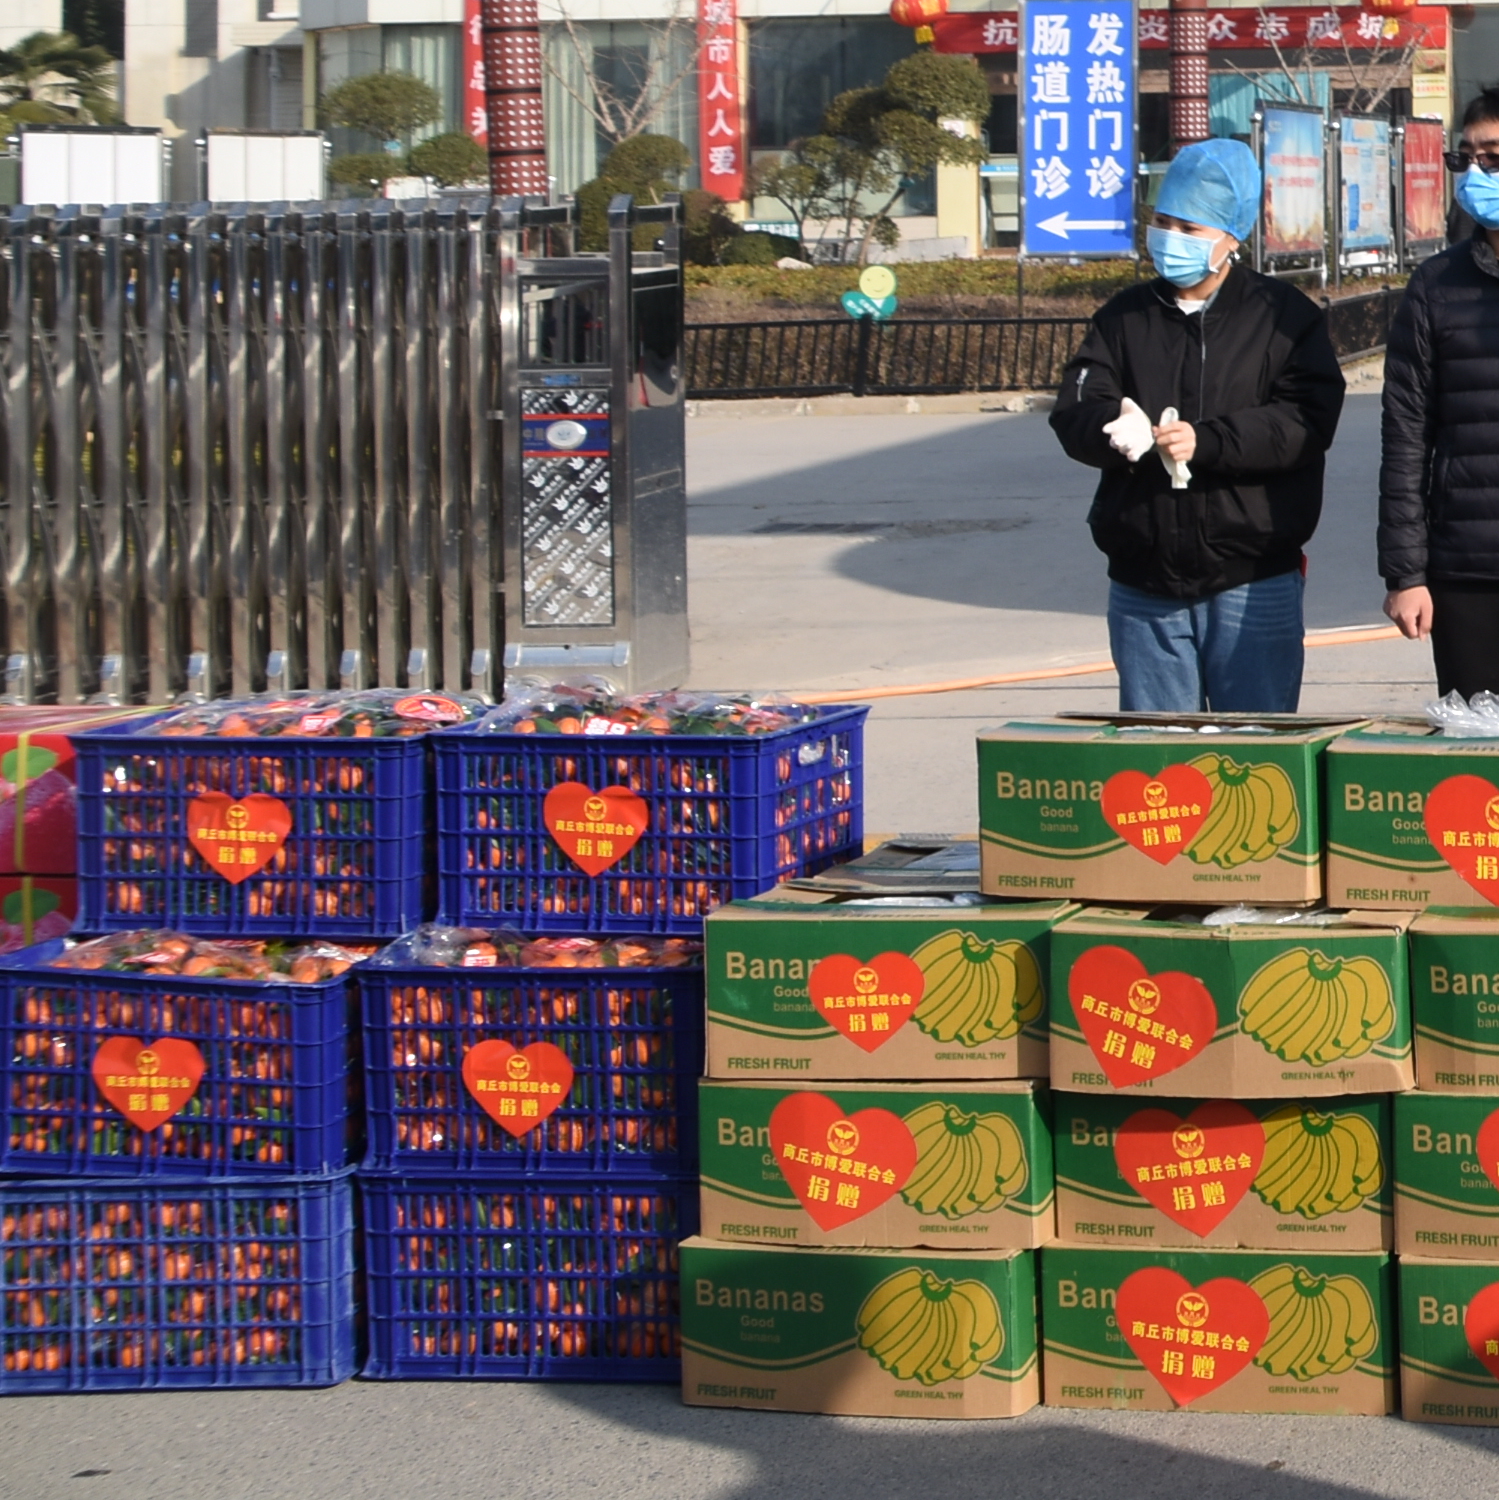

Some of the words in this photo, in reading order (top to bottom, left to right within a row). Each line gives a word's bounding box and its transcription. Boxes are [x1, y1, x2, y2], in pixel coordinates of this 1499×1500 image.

[1031, 14, 1072, 200] 肠道门诊
[1085, 12, 1126, 200] 发热门诊
[1040, 806, 1073, 818] Good
[1116, 803, 1201, 825] 商丘市博爱联合会
[555, 820, 635, 836] 商丘市博爱联合会
[1040, 821, 1079, 833] banana
[1142, 824, 1182, 846] 捐赠
[197, 828, 277, 843] 商丘市博爱联合会
[577, 838, 613, 857] 捐赠
[998, 875, 1037, 888] FRESH
[1040, 877, 1076, 889] FRUIT
[1193, 874, 1220, 882] GREEN
[1346, 888, 1388, 900] FRESH
[1391, 889, 1431, 902] FRUIT
[823, 993, 912, 1009] 商丘市博爱联合会
[849, 1013, 890, 1032] 捐赠
[1081, 994, 1194, 1050] 商丘市博爱联合会
[935, 1052, 964, 1060] GREEN
[1102, 1030, 1156, 1069] 捐赠
[728, 1057, 770, 1070] FRESH
[773, 1058, 811, 1070] FRUIT
[1281, 1072, 1311, 1080] GREEN
[1435, 1072, 1475, 1086] FRESH
[477, 1080, 561, 1094] 商丘市博爱联合会
[500, 1097, 538, 1116] 捐赠
[783, 1143, 896, 1185] 商丘市博爱联合会
[1136, 1153, 1252, 1183] 商丘市博爱联合会
[807, 1175, 861, 1209] 捐赠
[1172, 1181, 1226, 1211] 捐赠
[721, 1223, 760, 1237] FRESH
[762, 1226, 798, 1239] FRUIT
[919, 1224, 946, 1233] GREEN
[1075, 1223, 1115, 1235] FRESH
[1118, 1224, 1155, 1238] FRUIT
[1277, 1224, 1304, 1232] GREEN
[1415, 1231, 1457, 1245] FRESH
[1461, 1233, 1499, 1247] FRUIT
[696, 1279, 825, 1313] Bananas
[741, 1315, 775, 1329] Good
[740, 1331, 780, 1344] banana
[1132, 1321, 1250, 1352] 商丘市博爱联合会
[1161, 1350, 1215, 1380] 捐赠
[697, 1383, 738, 1398] FRESH
[740, 1385, 777, 1400] FRUIT
[894, 1389, 921, 1399] GREEN
[1061, 1386, 1103, 1399] FRESH
[1107, 1387, 1145, 1400] FRUIT
[1268, 1386, 1297, 1394] GREEN
[1422, 1402, 1464, 1417] FRESH
